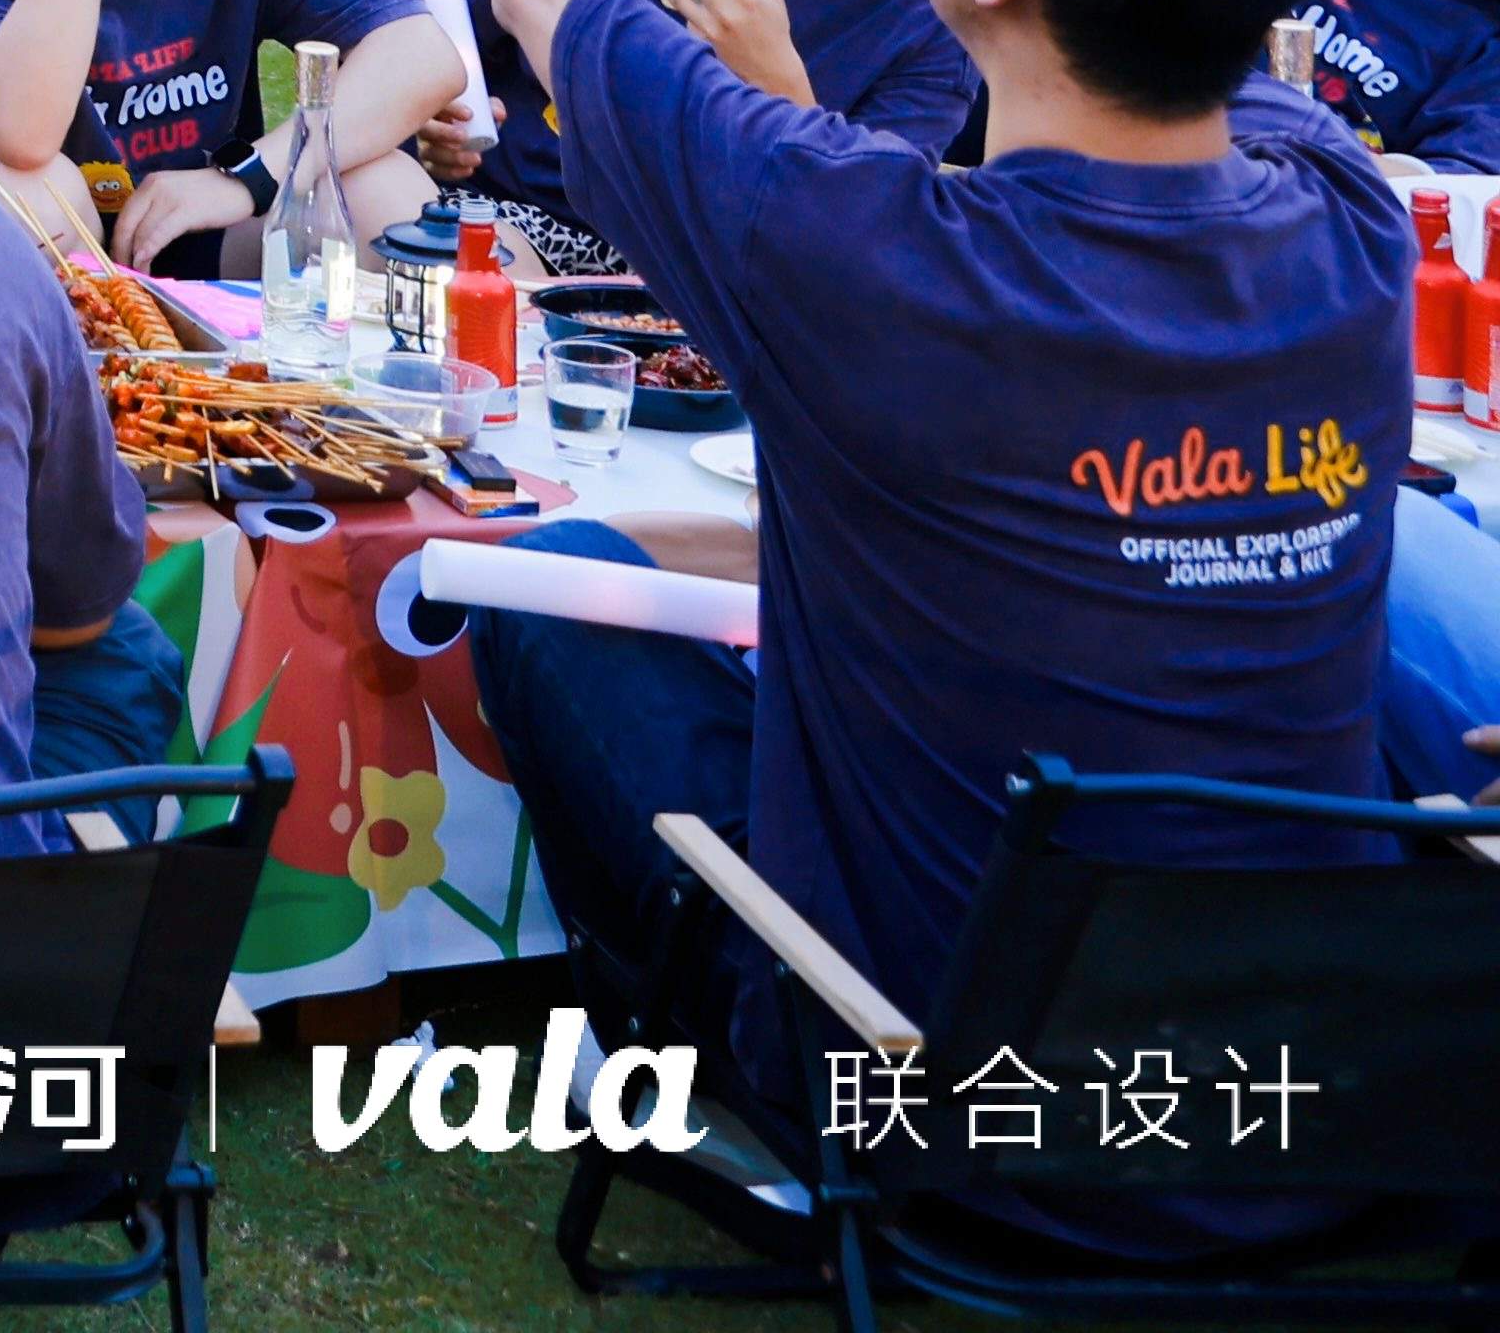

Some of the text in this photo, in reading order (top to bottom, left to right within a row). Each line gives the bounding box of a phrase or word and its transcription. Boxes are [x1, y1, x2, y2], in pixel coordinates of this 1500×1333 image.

[118, 64, 229, 125] Home
[130, 118, 199, 161] CLUB
[1070, 418, 1369, 517] Vala Life
[1119, 535, 1230, 564] OFFICIAL
[1164, 545, 1334, 589] JOURNAL & KIT
